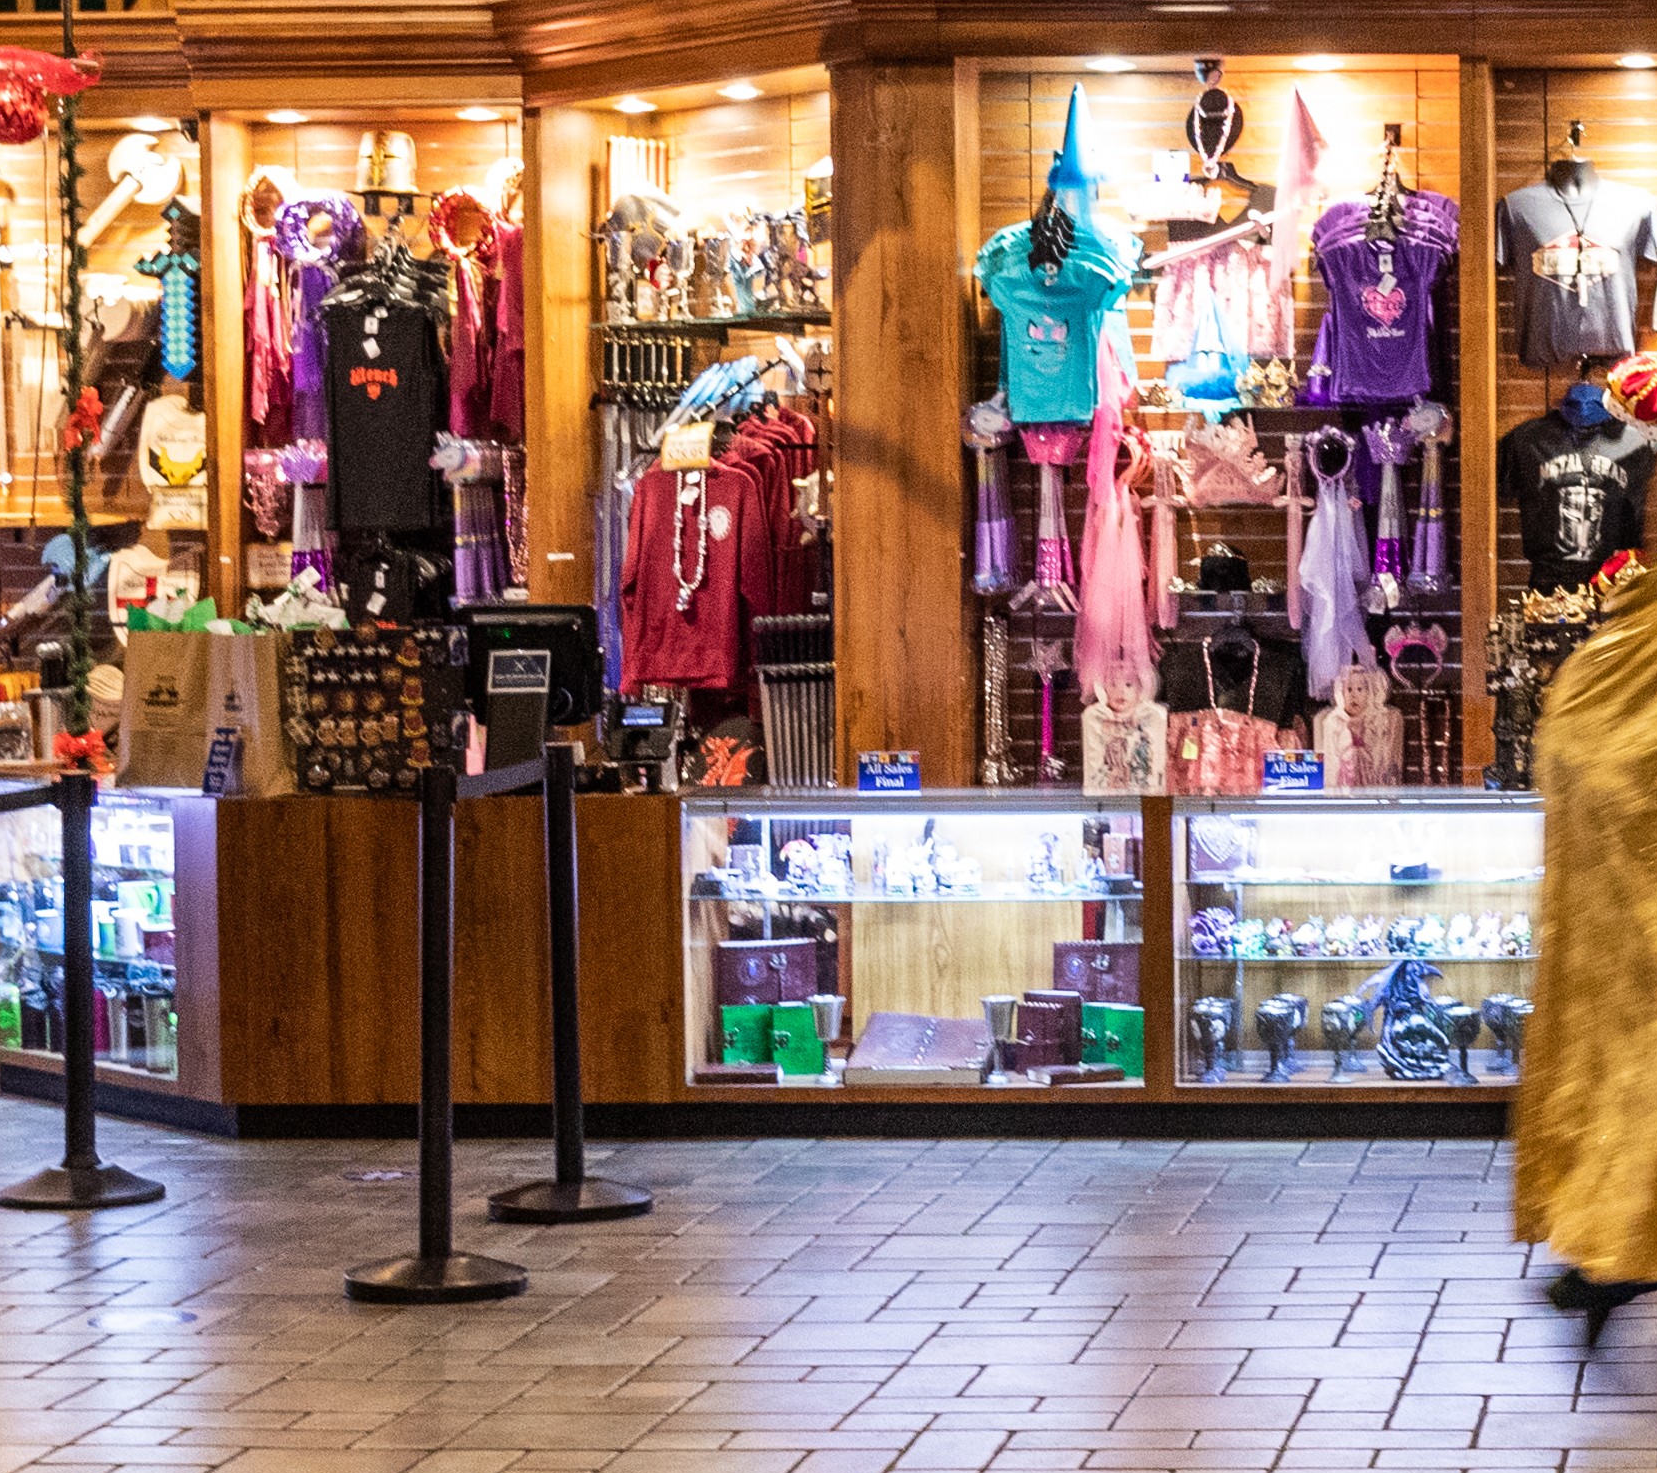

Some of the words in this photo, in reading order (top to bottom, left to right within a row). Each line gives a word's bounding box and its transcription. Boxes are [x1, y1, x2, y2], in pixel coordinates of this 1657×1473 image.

[866, 762, 881, 774] All
[883, 762, 913, 774] Sales
[1271, 762, 1286, 773] All
[1289, 762, 1318, 773] Sales
[875, 776, 904, 787] Final
[1279, 775, 1308, 787] Final
